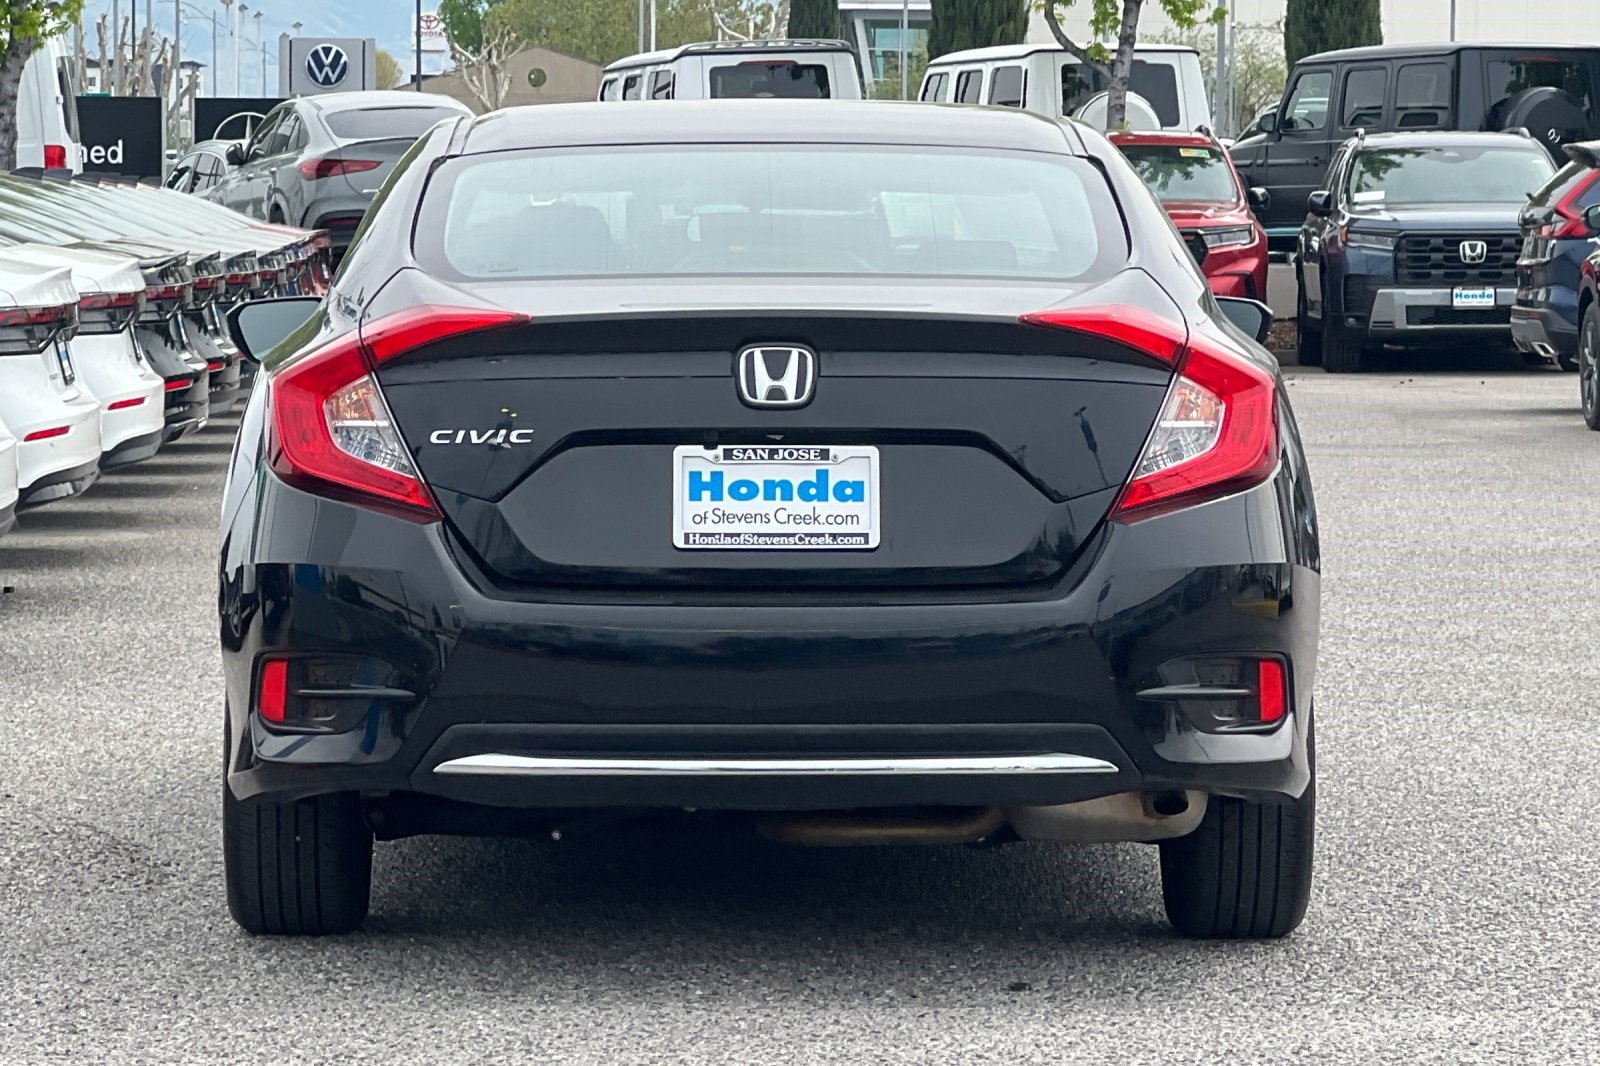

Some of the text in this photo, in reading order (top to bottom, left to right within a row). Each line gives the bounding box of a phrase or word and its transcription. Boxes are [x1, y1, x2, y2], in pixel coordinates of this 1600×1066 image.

[81, 139, 123, 164] ned
[430, 429, 534, 444] CIVIC
[732, 448, 821, 460] SAN JOSE
[688, 469, 865, 502] Honda
[692, 506, 860, 525] of Stevens Creek.com
[688, 533, 865, 546] HondaofStevensCreek.com
